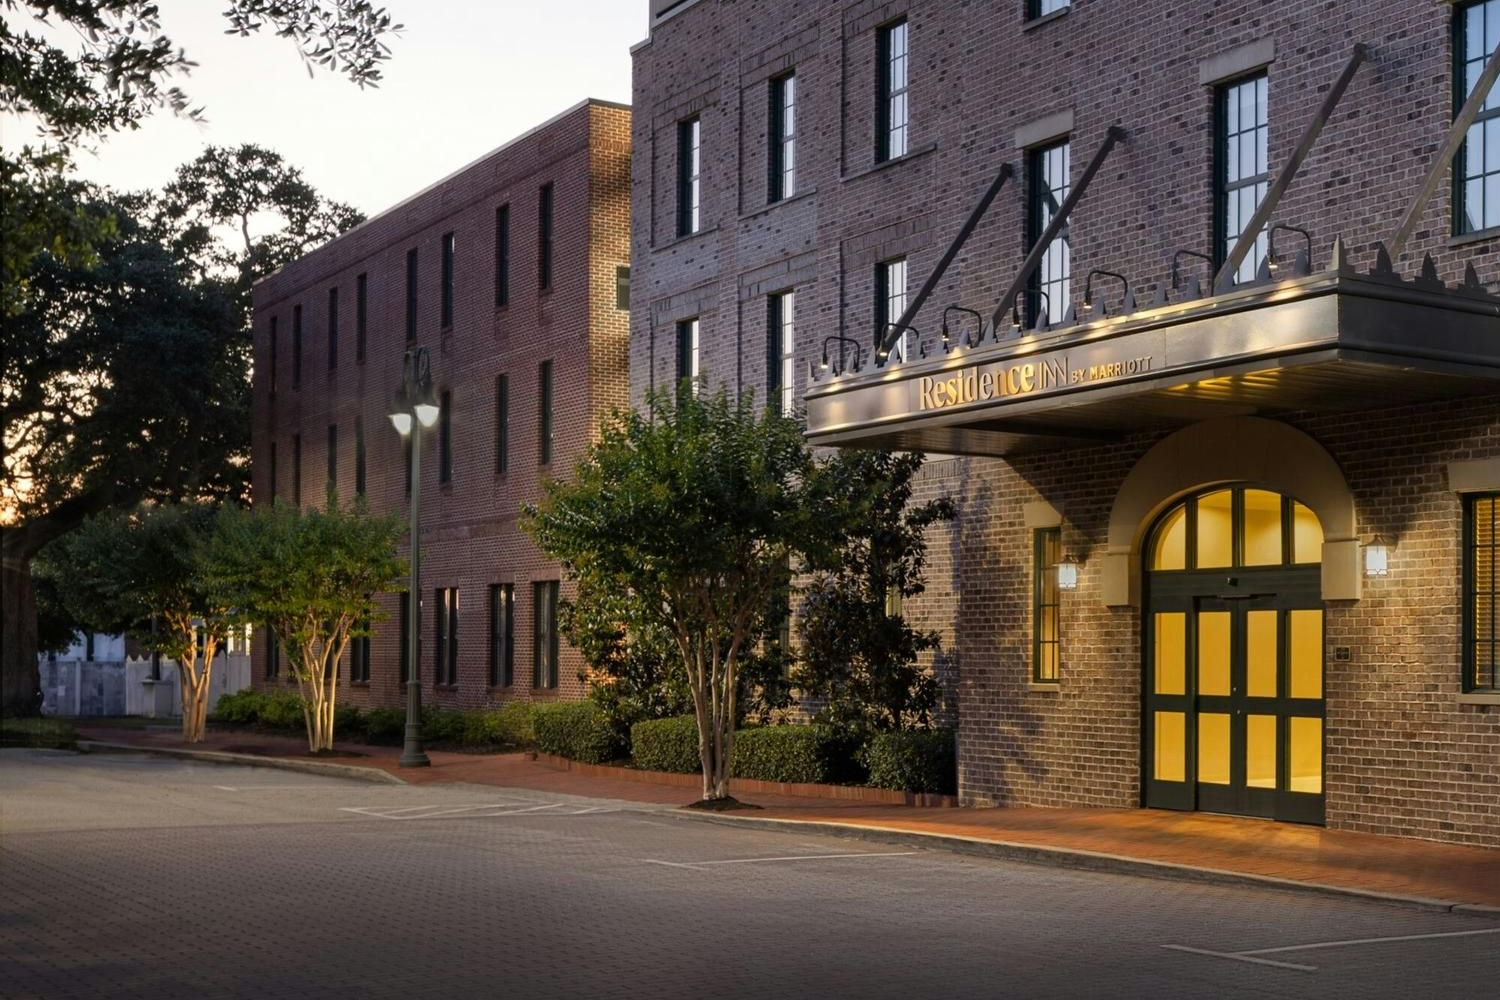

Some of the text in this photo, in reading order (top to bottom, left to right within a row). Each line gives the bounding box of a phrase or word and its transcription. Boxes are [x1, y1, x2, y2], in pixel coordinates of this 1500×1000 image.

[919, 356, 1153, 411] Residence INN BY MARRIOTT
